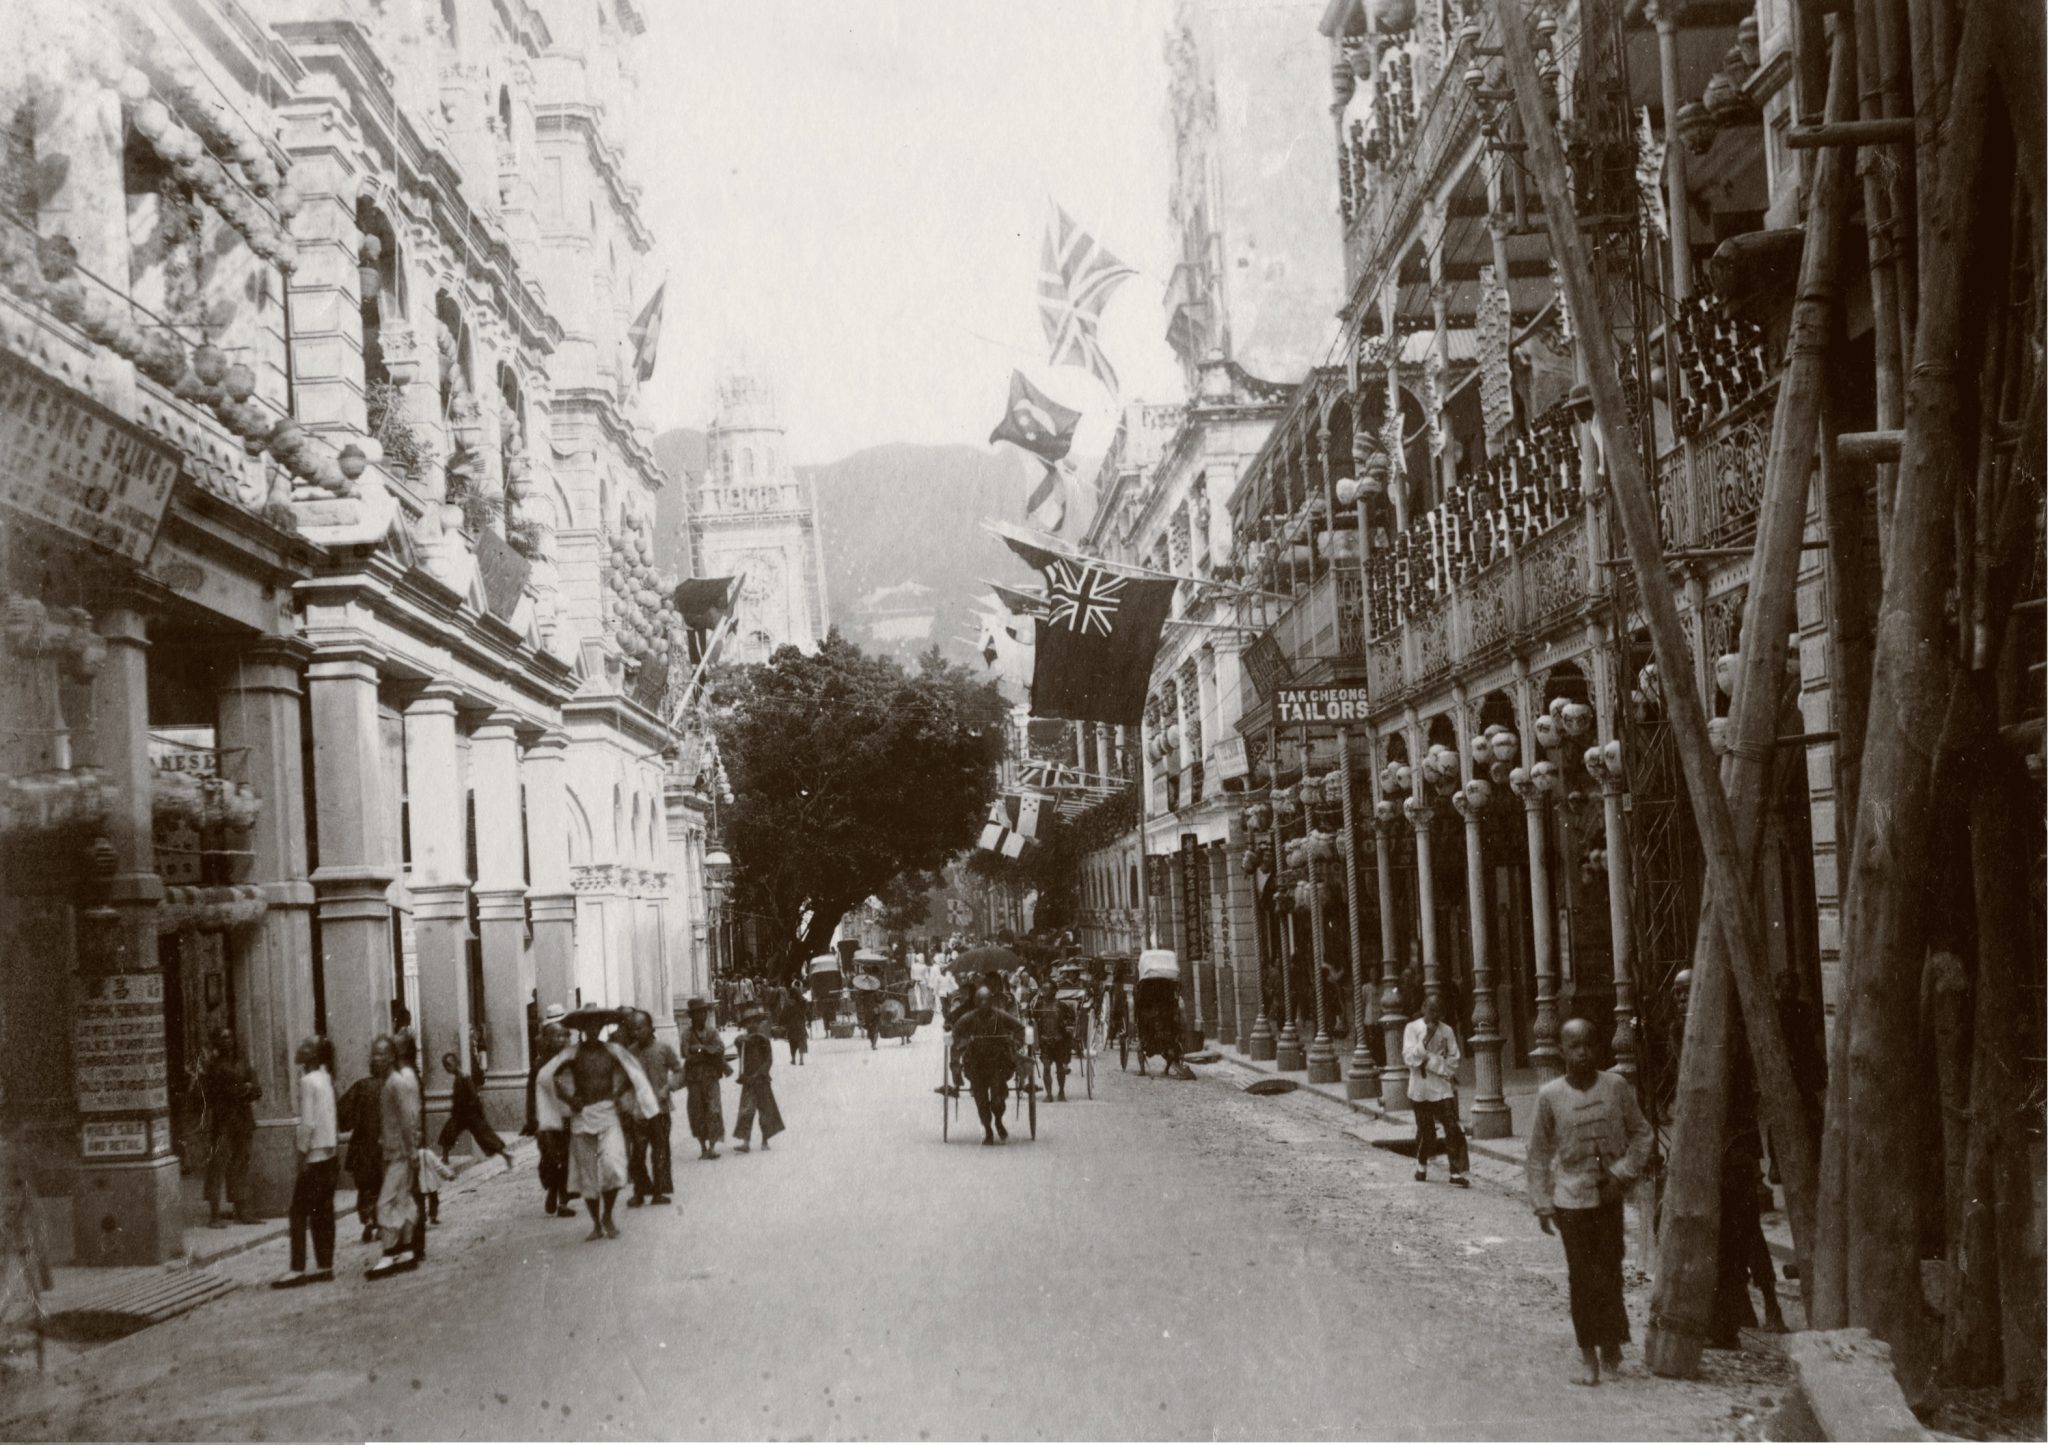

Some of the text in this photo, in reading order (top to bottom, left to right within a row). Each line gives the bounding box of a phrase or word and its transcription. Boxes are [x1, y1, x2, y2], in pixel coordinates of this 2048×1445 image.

[1278, 688, 1368, 703] TAK CHEONG
[1278, 701, 1369, 722] TAILORS
